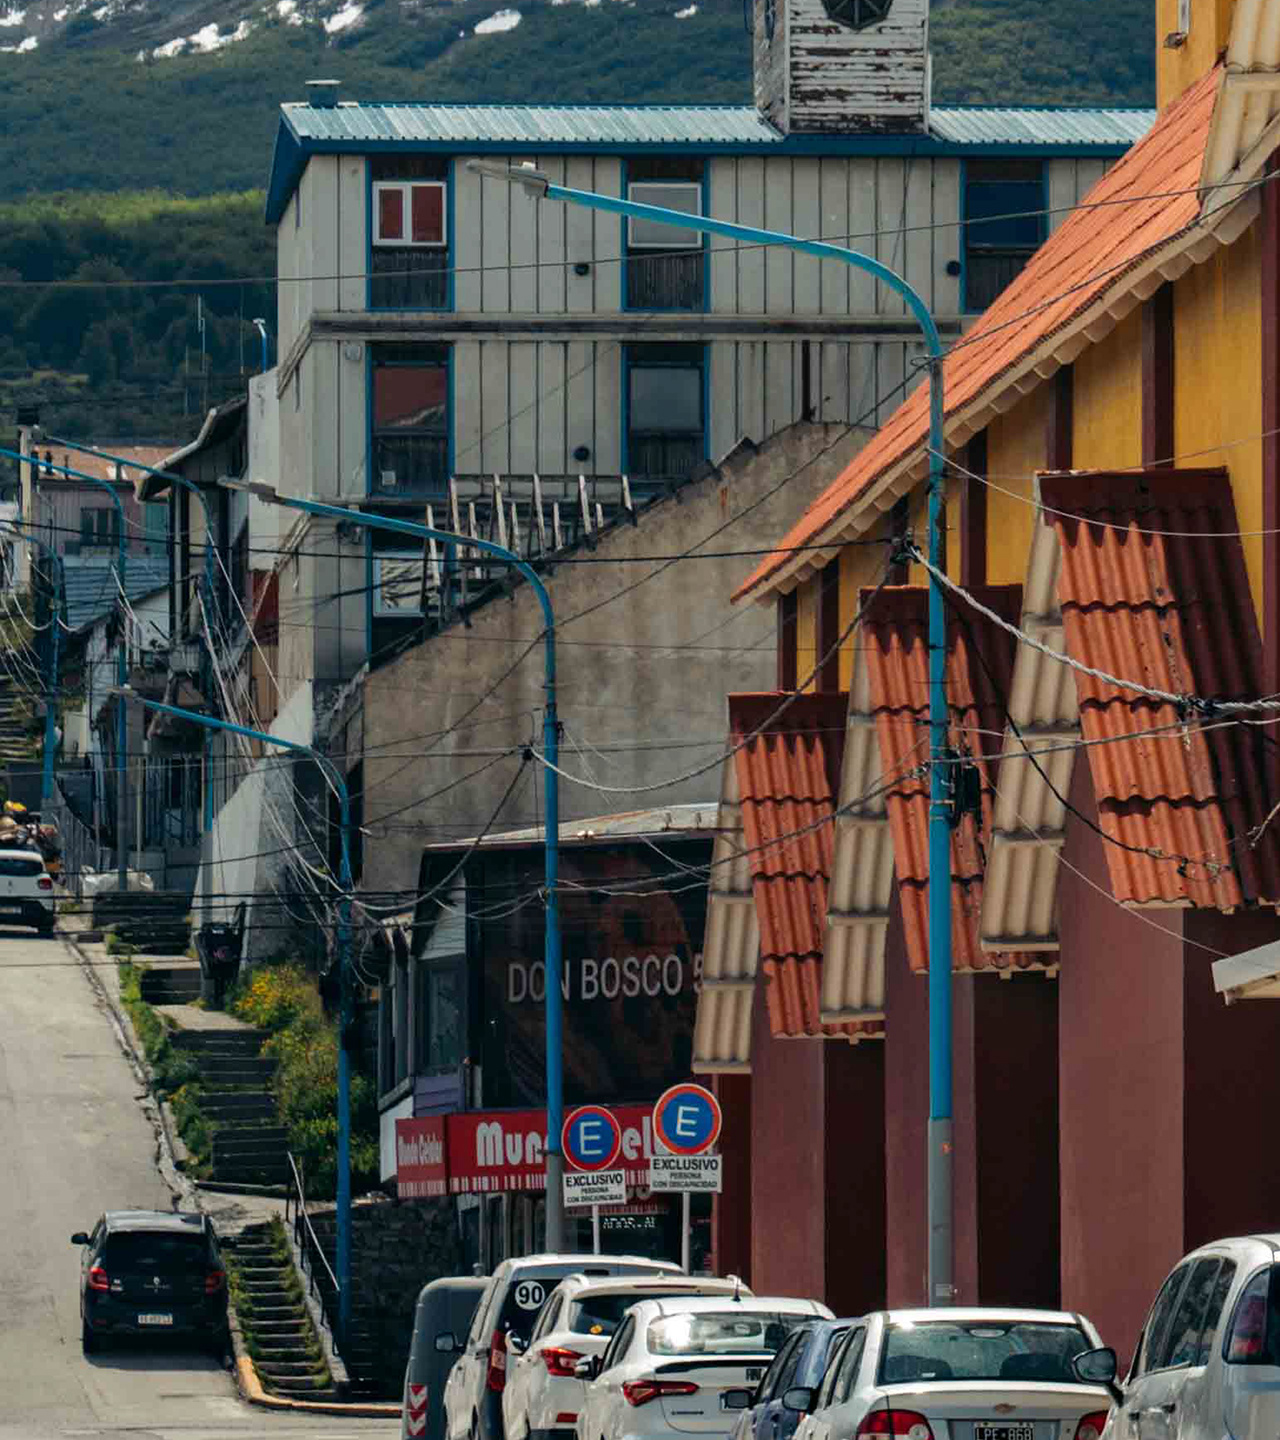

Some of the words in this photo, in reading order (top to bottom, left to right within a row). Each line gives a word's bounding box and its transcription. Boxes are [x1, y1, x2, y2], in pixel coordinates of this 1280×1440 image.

[581, 954, 683, 1001] BOSCO
[676, 1105, 699, 1137] E
[476, 1121, 549, 1167] Mun
[579, 1121, 602, 1155] E
[566, 1173, 624, 1187] EXCLUSIVO
[652, 1158, 719, 1171] EXCLUSIVO
[519, 1285, 542, 1304] 90
